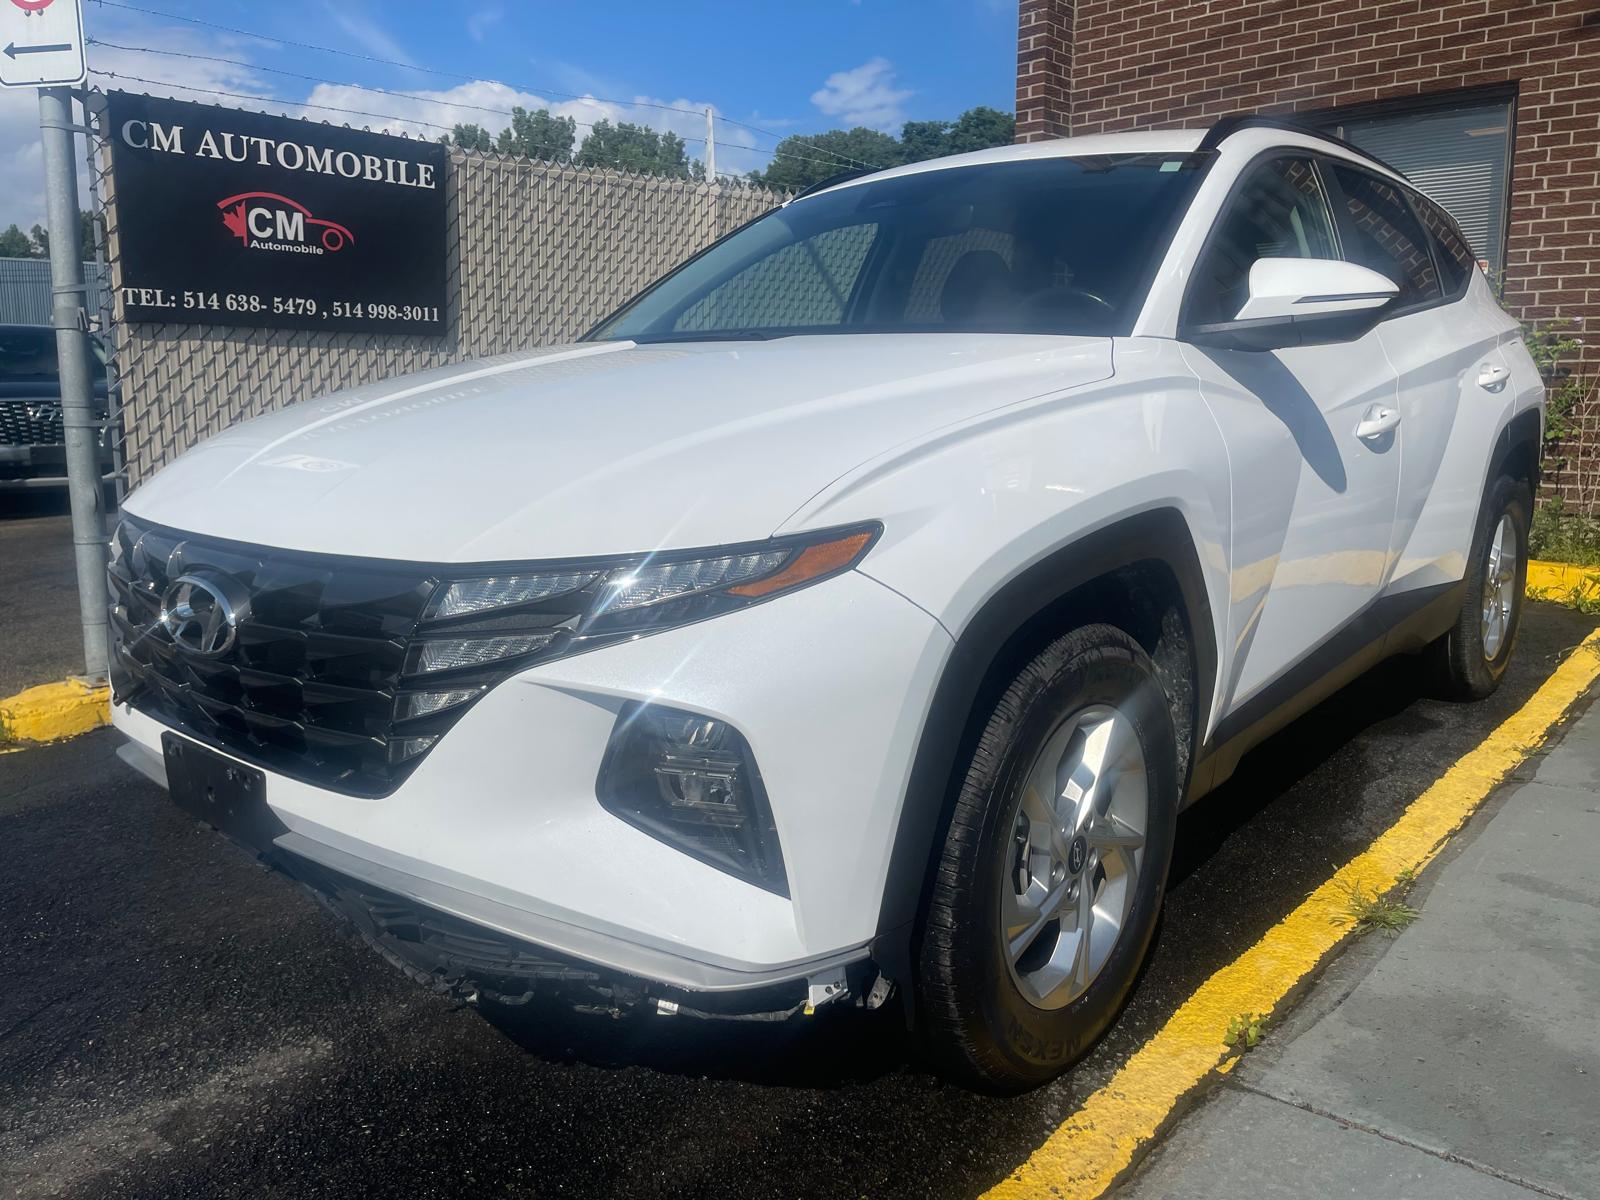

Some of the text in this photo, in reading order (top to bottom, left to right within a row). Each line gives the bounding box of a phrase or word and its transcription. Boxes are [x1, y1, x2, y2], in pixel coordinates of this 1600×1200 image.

[122, 119, 436, 189] CM AUTOMOBILE
[247, 207, 304, 241] CM
[250, 239, 323, 255] Automobile
[121, 287, 176, 307] TEL:
[183, 291, 220, 310] 514
[273, 297, 317, 316] 5479
[332, 301, 363, 318] 514
[368, 303, 439, 322] 998-3011
